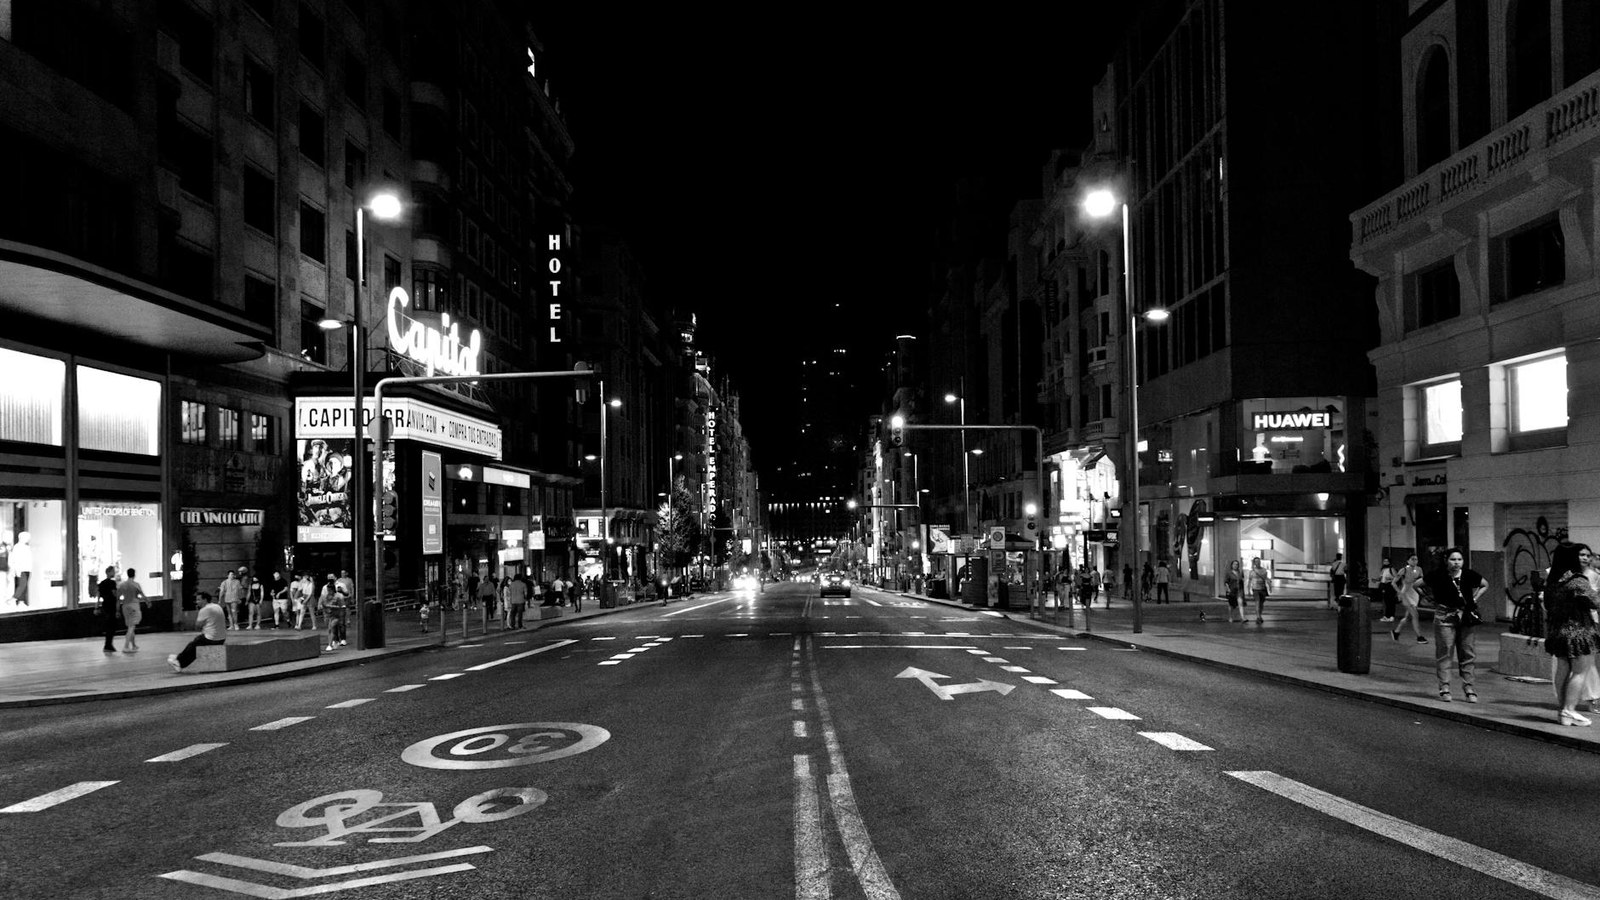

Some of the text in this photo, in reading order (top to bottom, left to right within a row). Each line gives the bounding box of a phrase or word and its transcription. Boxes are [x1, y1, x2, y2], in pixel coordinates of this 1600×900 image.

[387, 286, 481, 378] Capitol
[548, 234, 562, 343] HOTEL
[707, 411, 717, 529] HOTEL EMPERADO
[1254, 412, 1330, 429] HUAWEI
